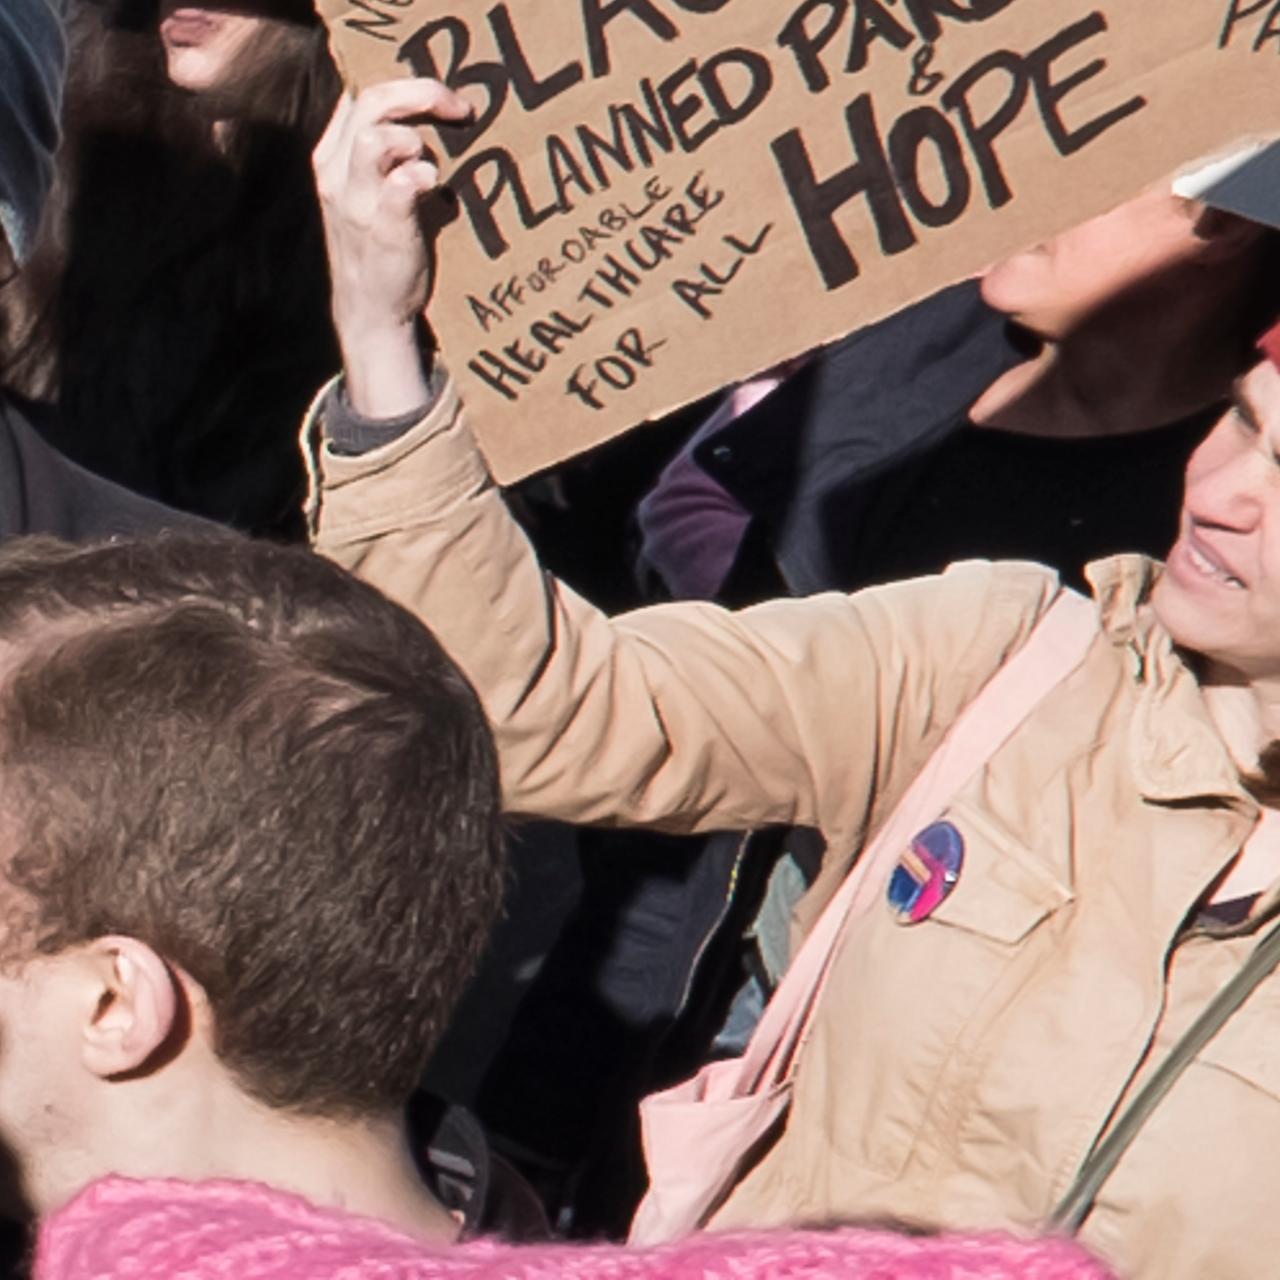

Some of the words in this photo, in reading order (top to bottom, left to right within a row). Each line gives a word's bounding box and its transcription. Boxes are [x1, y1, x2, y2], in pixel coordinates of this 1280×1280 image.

[446, 47, 775, 263] PLANNED
[769, 10, 1150, 292] HOPE
[908, 42, 946, 99] &
[465, 174, 674, 333] AFFORDABLE
[467, 169, 726, 402] HEALTHCARE
[565, 325, 670, 411] FOR
[671, 222, 776, 321] ALL
